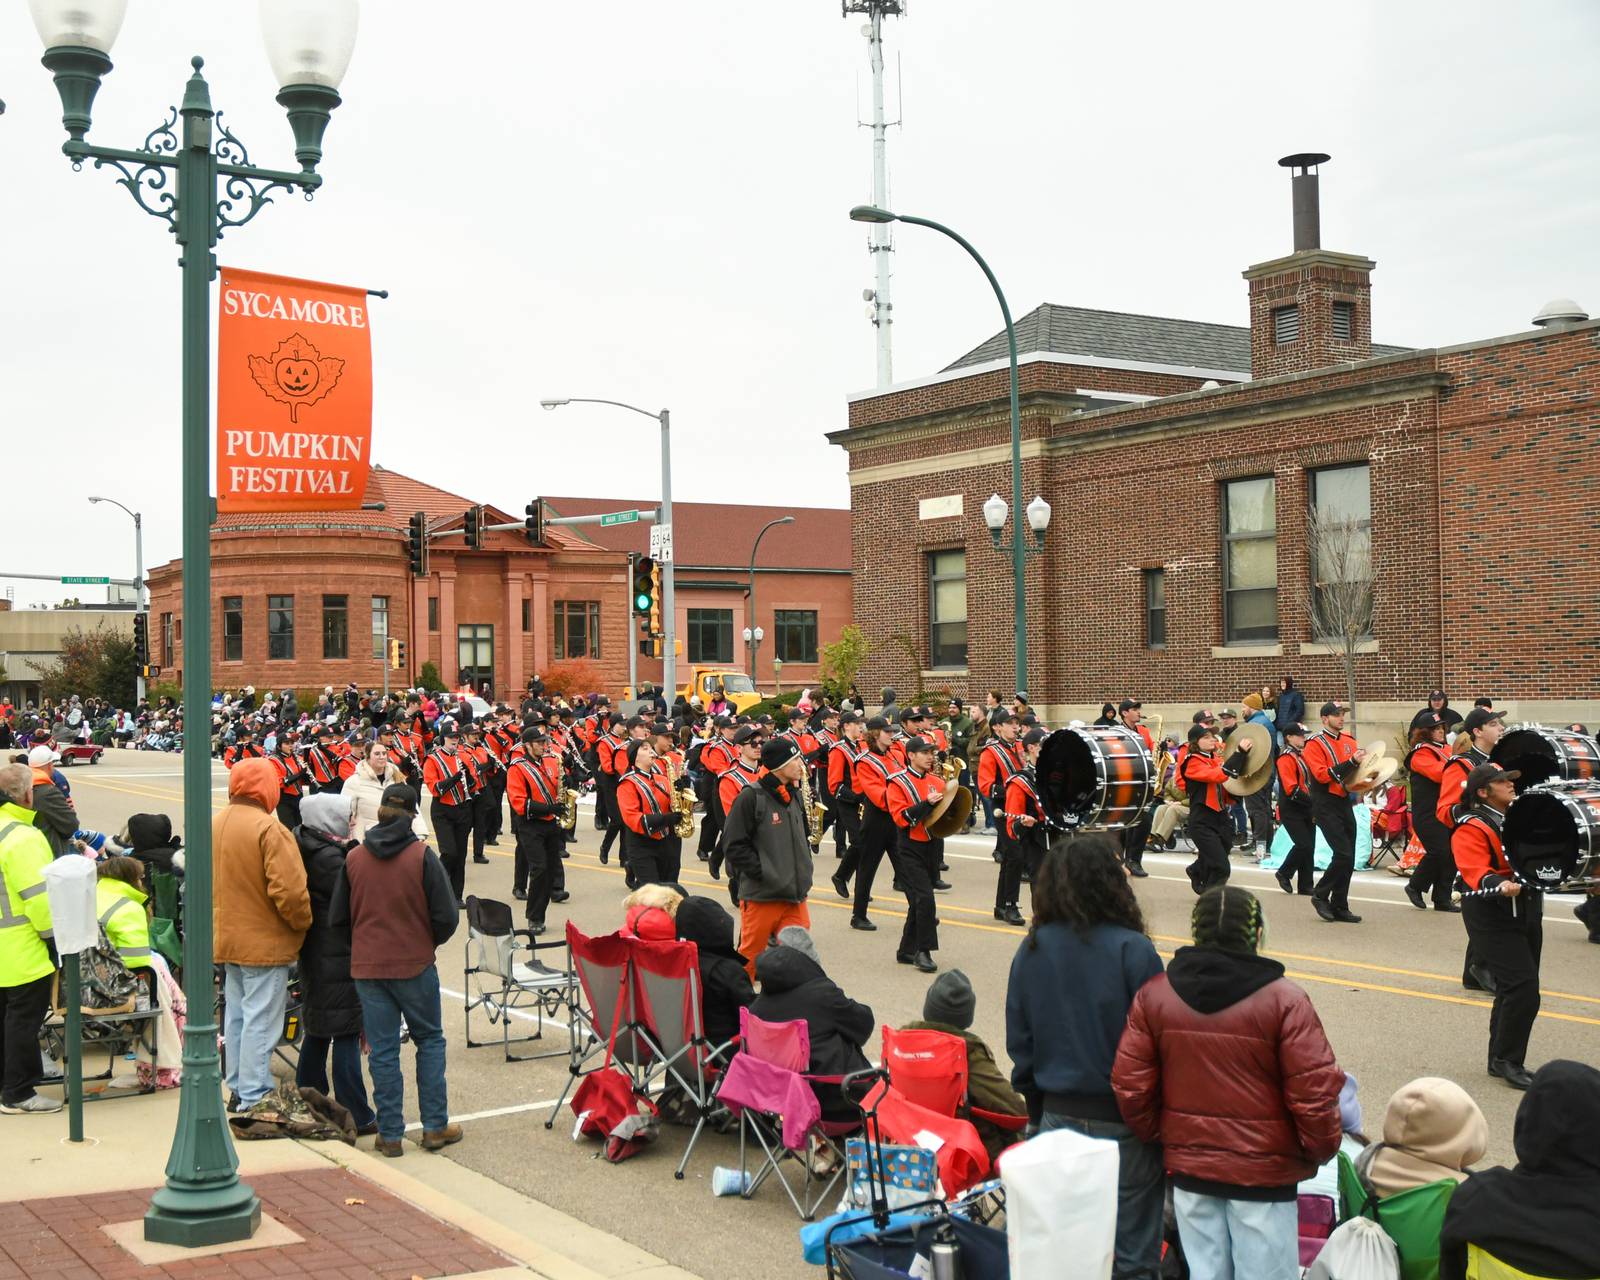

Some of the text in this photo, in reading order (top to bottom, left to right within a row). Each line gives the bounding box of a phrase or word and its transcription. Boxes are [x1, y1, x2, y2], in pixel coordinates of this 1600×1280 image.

[224, 289, 366, 328] SYCAMORE
[225, 430, 364, 462] PUMPKIN
[229, 466, 353, 494] FESTIVAL
[618, 512, 633, 521] STREET
[652, 534, 660, 546] 23
[662, 533, 671, 544] 64
